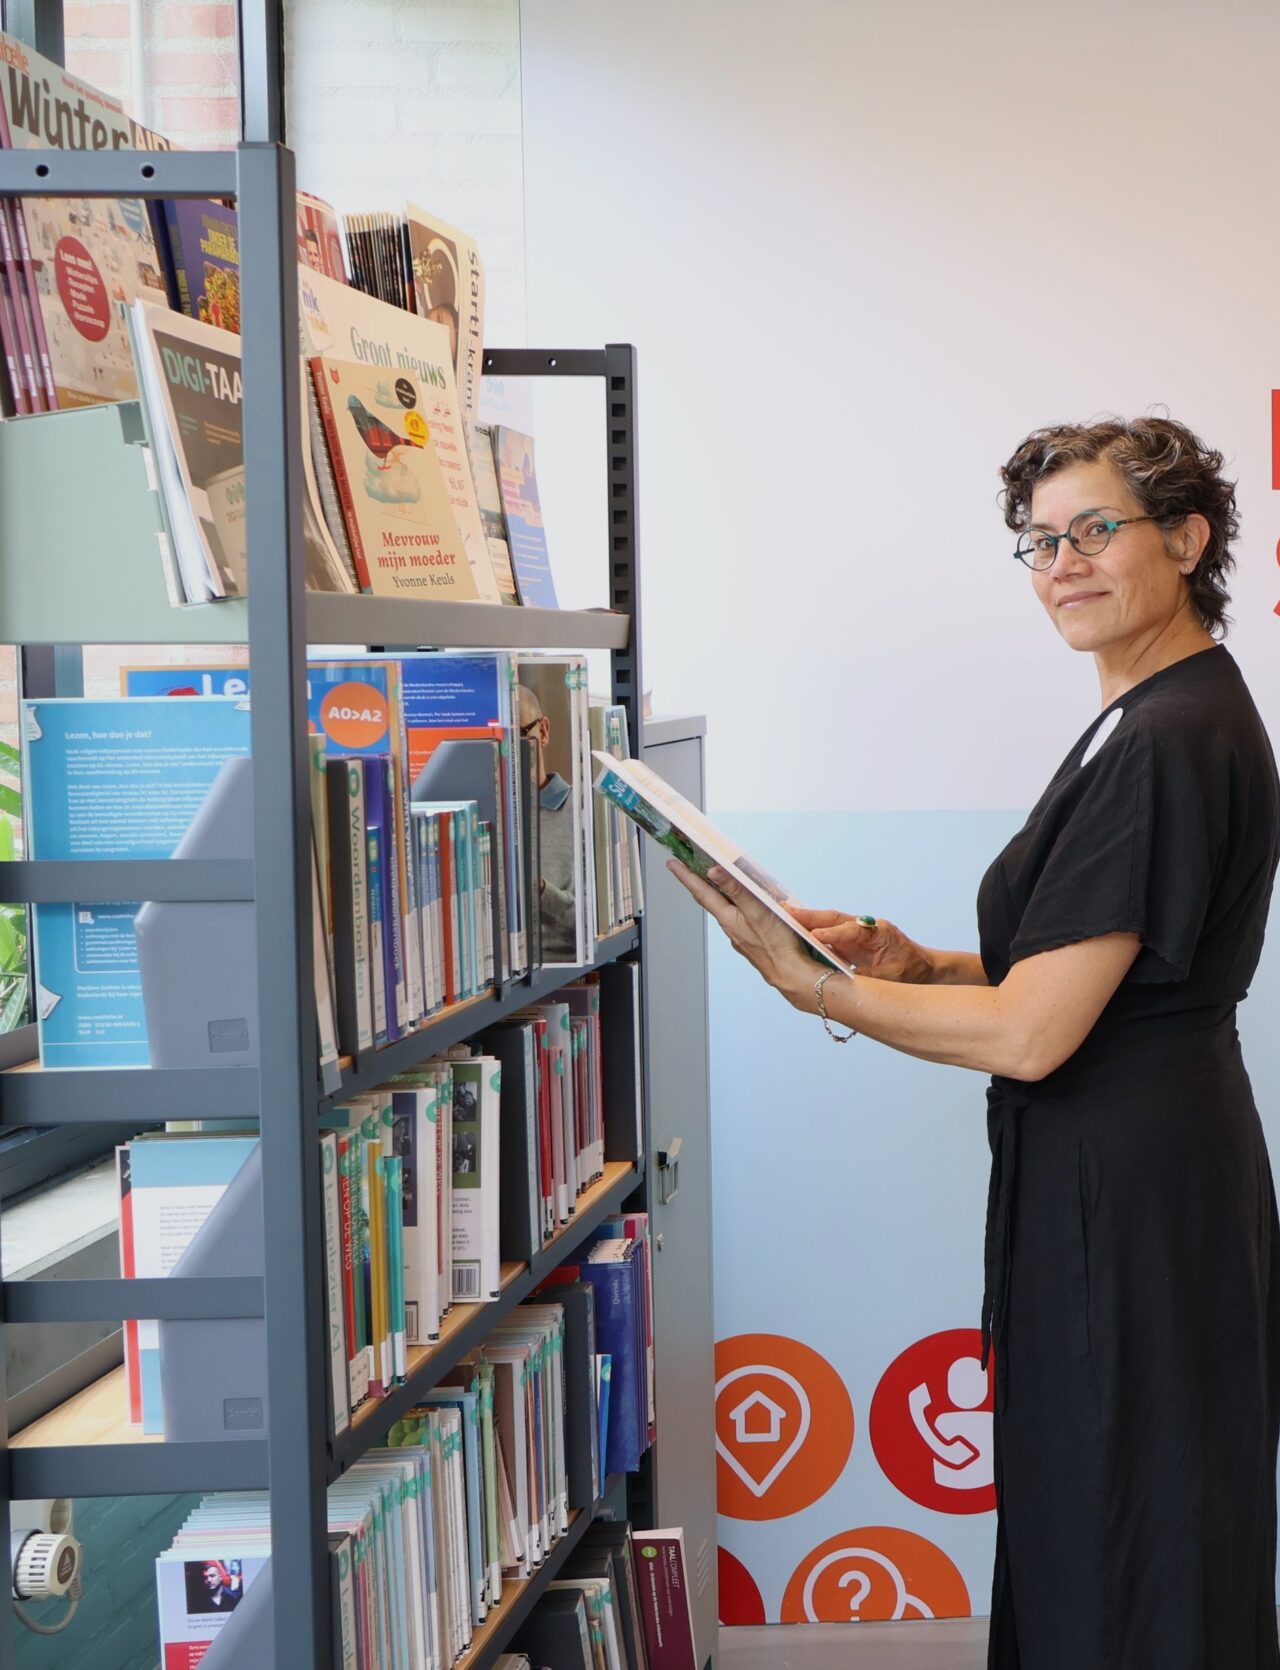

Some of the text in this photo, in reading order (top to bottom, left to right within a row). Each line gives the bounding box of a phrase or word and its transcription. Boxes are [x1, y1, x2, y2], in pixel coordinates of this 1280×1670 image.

[8, 66, 129, 150] Winter
[350, 325, 393, 369] Groot
[396, 345, 447, 390] nieuws
[382, 532, 440, 547] Mevrouw
[377, 550, 456, 572] mijn moeder
[392, 572, 456, 588] Yvonne Keuls
[328, 706, 383, 722] A0>A2
[65, 731, 92, 741] Lezen,
[92, 731, 109, 740] hoe
[109, 731, 125, 740] doe
[350, 806, 366, 999] Woordenboeken
[343, 1199, 351, 1216] OP
[326, 1182, 338, 1314] Leesplezier
[344, 1242, 352, 1270] WEG
